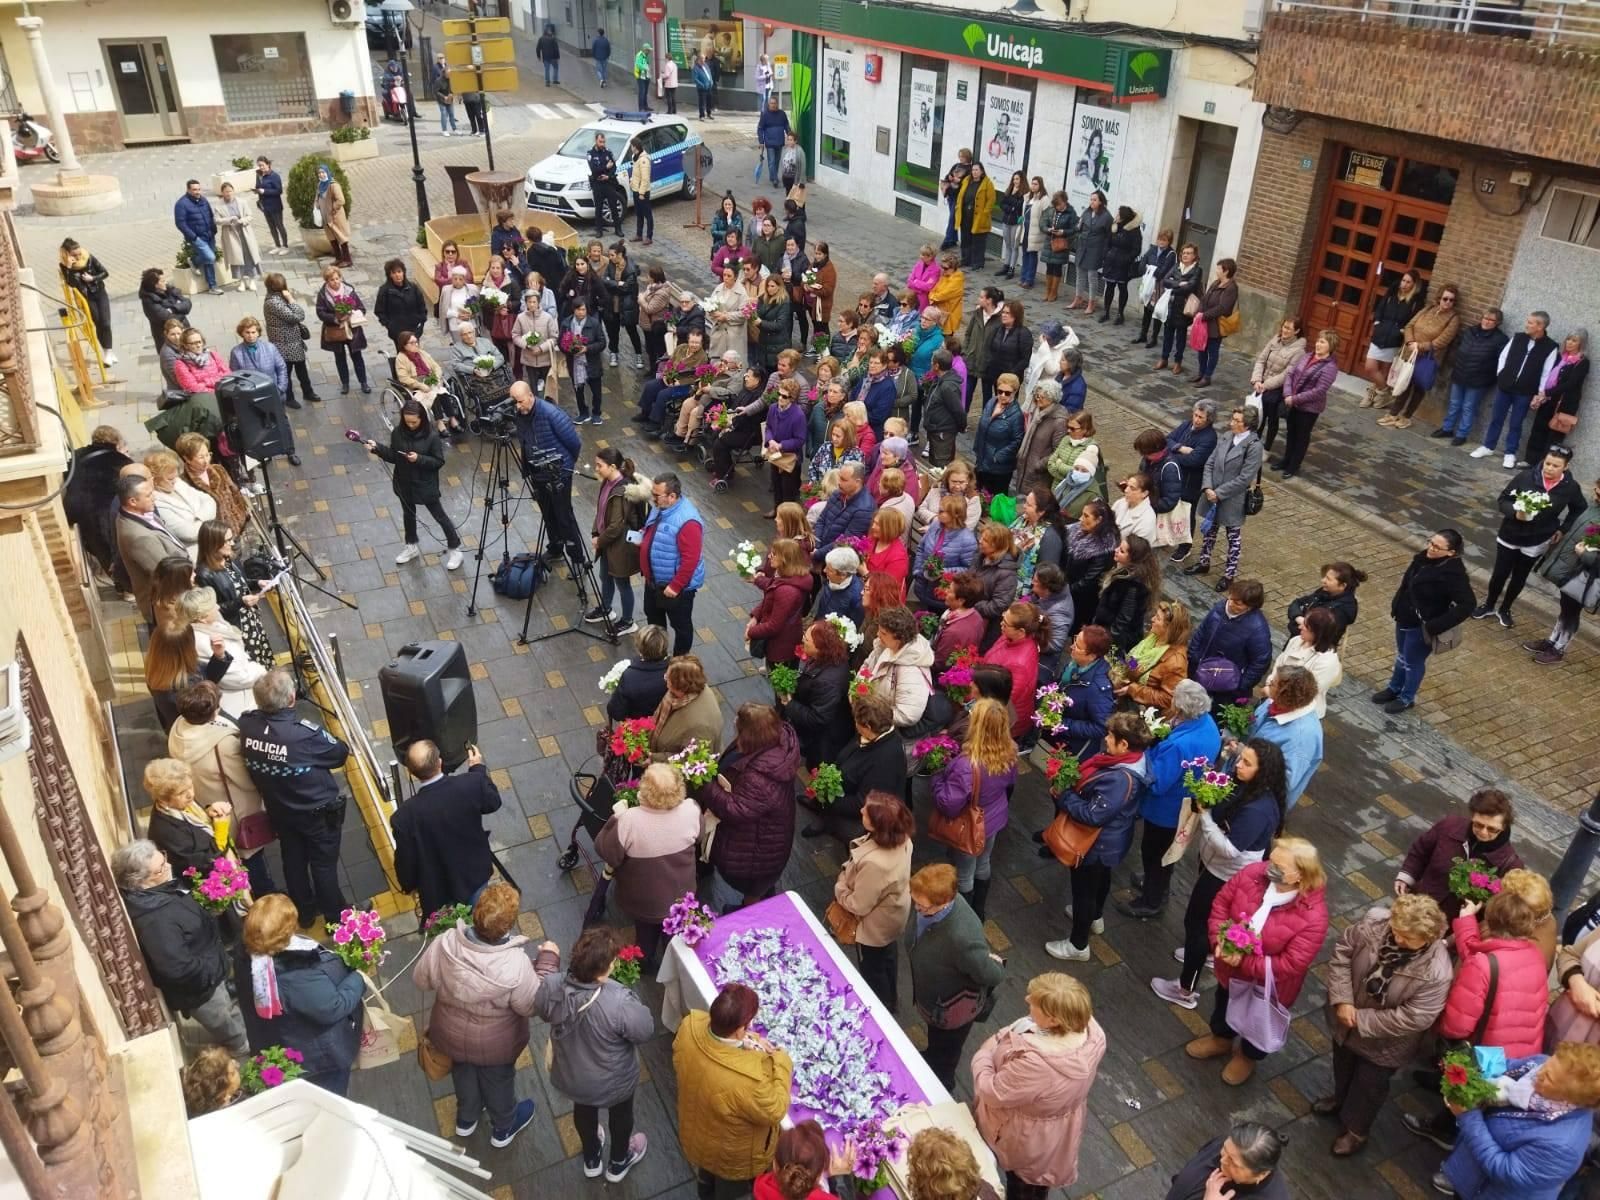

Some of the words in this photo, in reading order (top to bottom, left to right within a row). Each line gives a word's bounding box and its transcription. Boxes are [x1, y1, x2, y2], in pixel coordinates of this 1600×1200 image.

[987, 33, 1043, 69] Unicaja
[1129, 84, 1154, 95] Unicaja
[990, 96, 1010, 112] SOMOS
[1010, 100, 1024, 115] MÁS
[1081, 115, 1104, 131] SOMOS
[1104, 117, 1120, 136] MÁS
[1361, 156, 1384, 169] VENDE
[1481, 179, 1496, 193] 57
[245, 737, 288, 756] POLICIA
[267, 754, 288, 763] LOCAL
